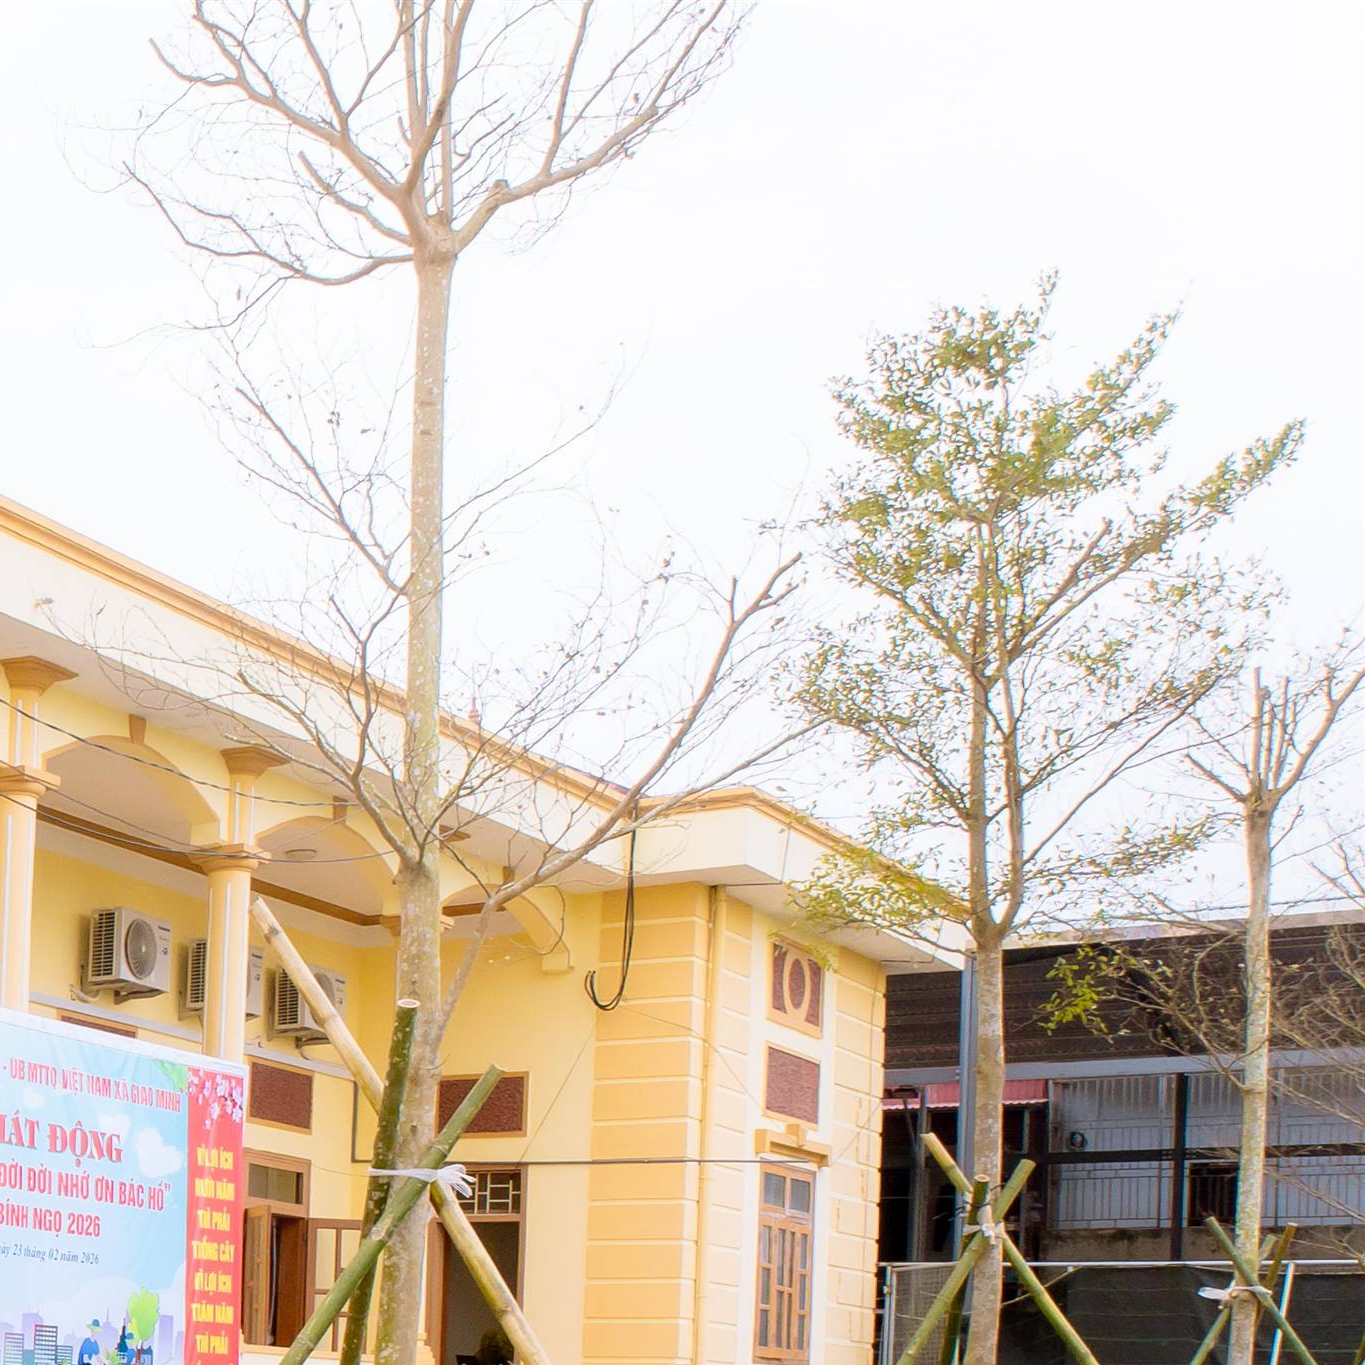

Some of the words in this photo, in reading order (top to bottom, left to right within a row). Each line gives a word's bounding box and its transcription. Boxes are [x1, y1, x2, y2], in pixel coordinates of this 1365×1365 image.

[10, 1058, 25, 1080] UB
[28, 1061, 58, 1088] MTTQ
[62, 1067, 84, 1096] VIỆT
[87, 1074, 112, 1099] NAM
[131, 1084, 153, 1107] GIAO
[156, 1089, 181, 1112] MINH
[47, 1121, 123, 1167] ĐỘNG
[27, 1163, 52, 1195] ĐỜI
[57, 1171, 90, 1200] NHỚ
[95, 1176, 114, 1203] ƠN
[119, 1178, 144, 1208] BÁC
[32, 1207, 62, 1238] NGỌ
[67, 1212, 101, 1237] 2026
[12, 1243, 23, 1256] 23
[24, 1245, 46, 1262] tháng
[48, 1247, 59, 1261] 02
[61, 1249, 78, 1263] năm
[80, 1251, 99, 1265] 2026
